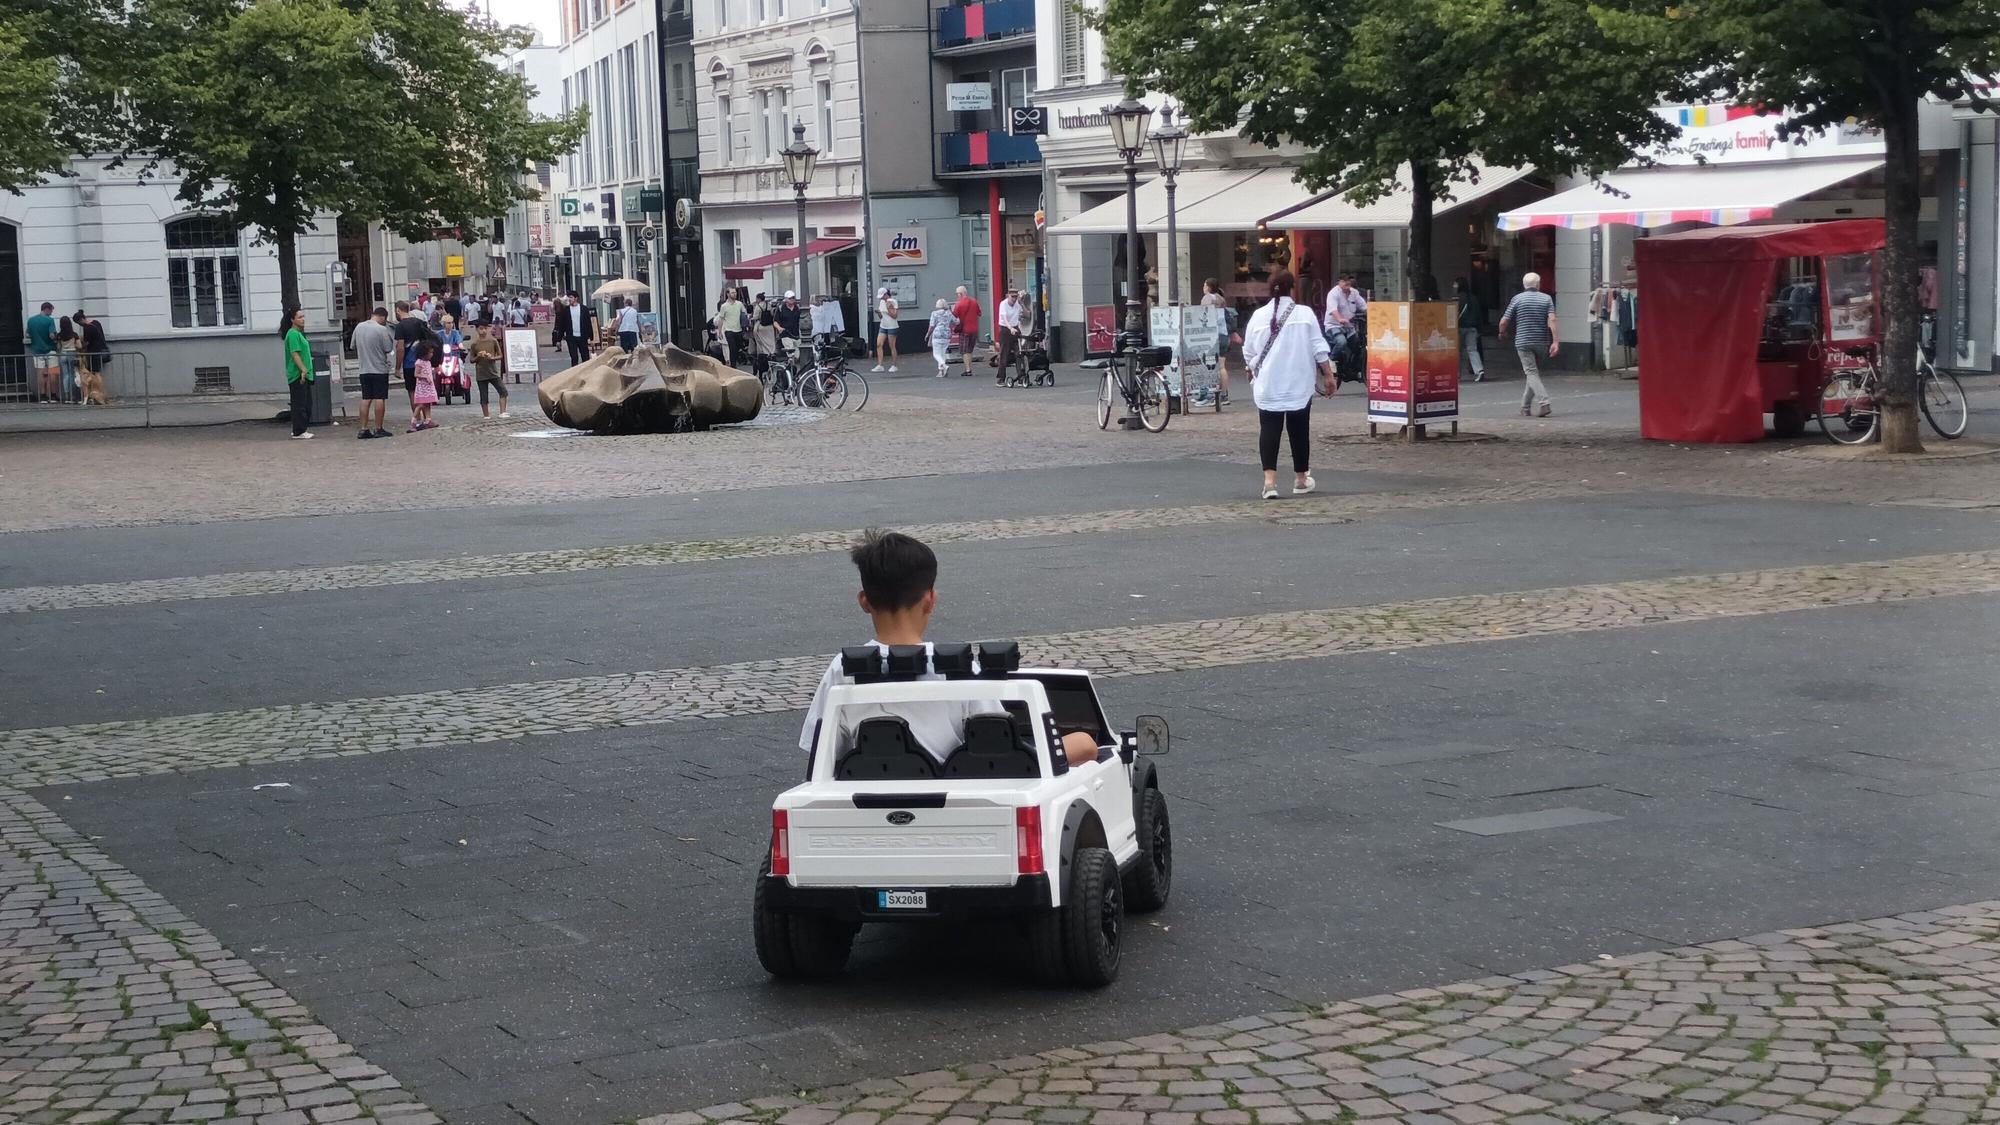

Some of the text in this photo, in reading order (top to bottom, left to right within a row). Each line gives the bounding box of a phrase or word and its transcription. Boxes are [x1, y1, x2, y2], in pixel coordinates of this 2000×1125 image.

[1058, 104, 1112, 129] hunkemöl
[564, 202, 576, 213] D
[891, 232, 918, 250] dm
[811, 834, 994, 848] SUPER DUTY
[888, 895, 924, 905] SX2088
